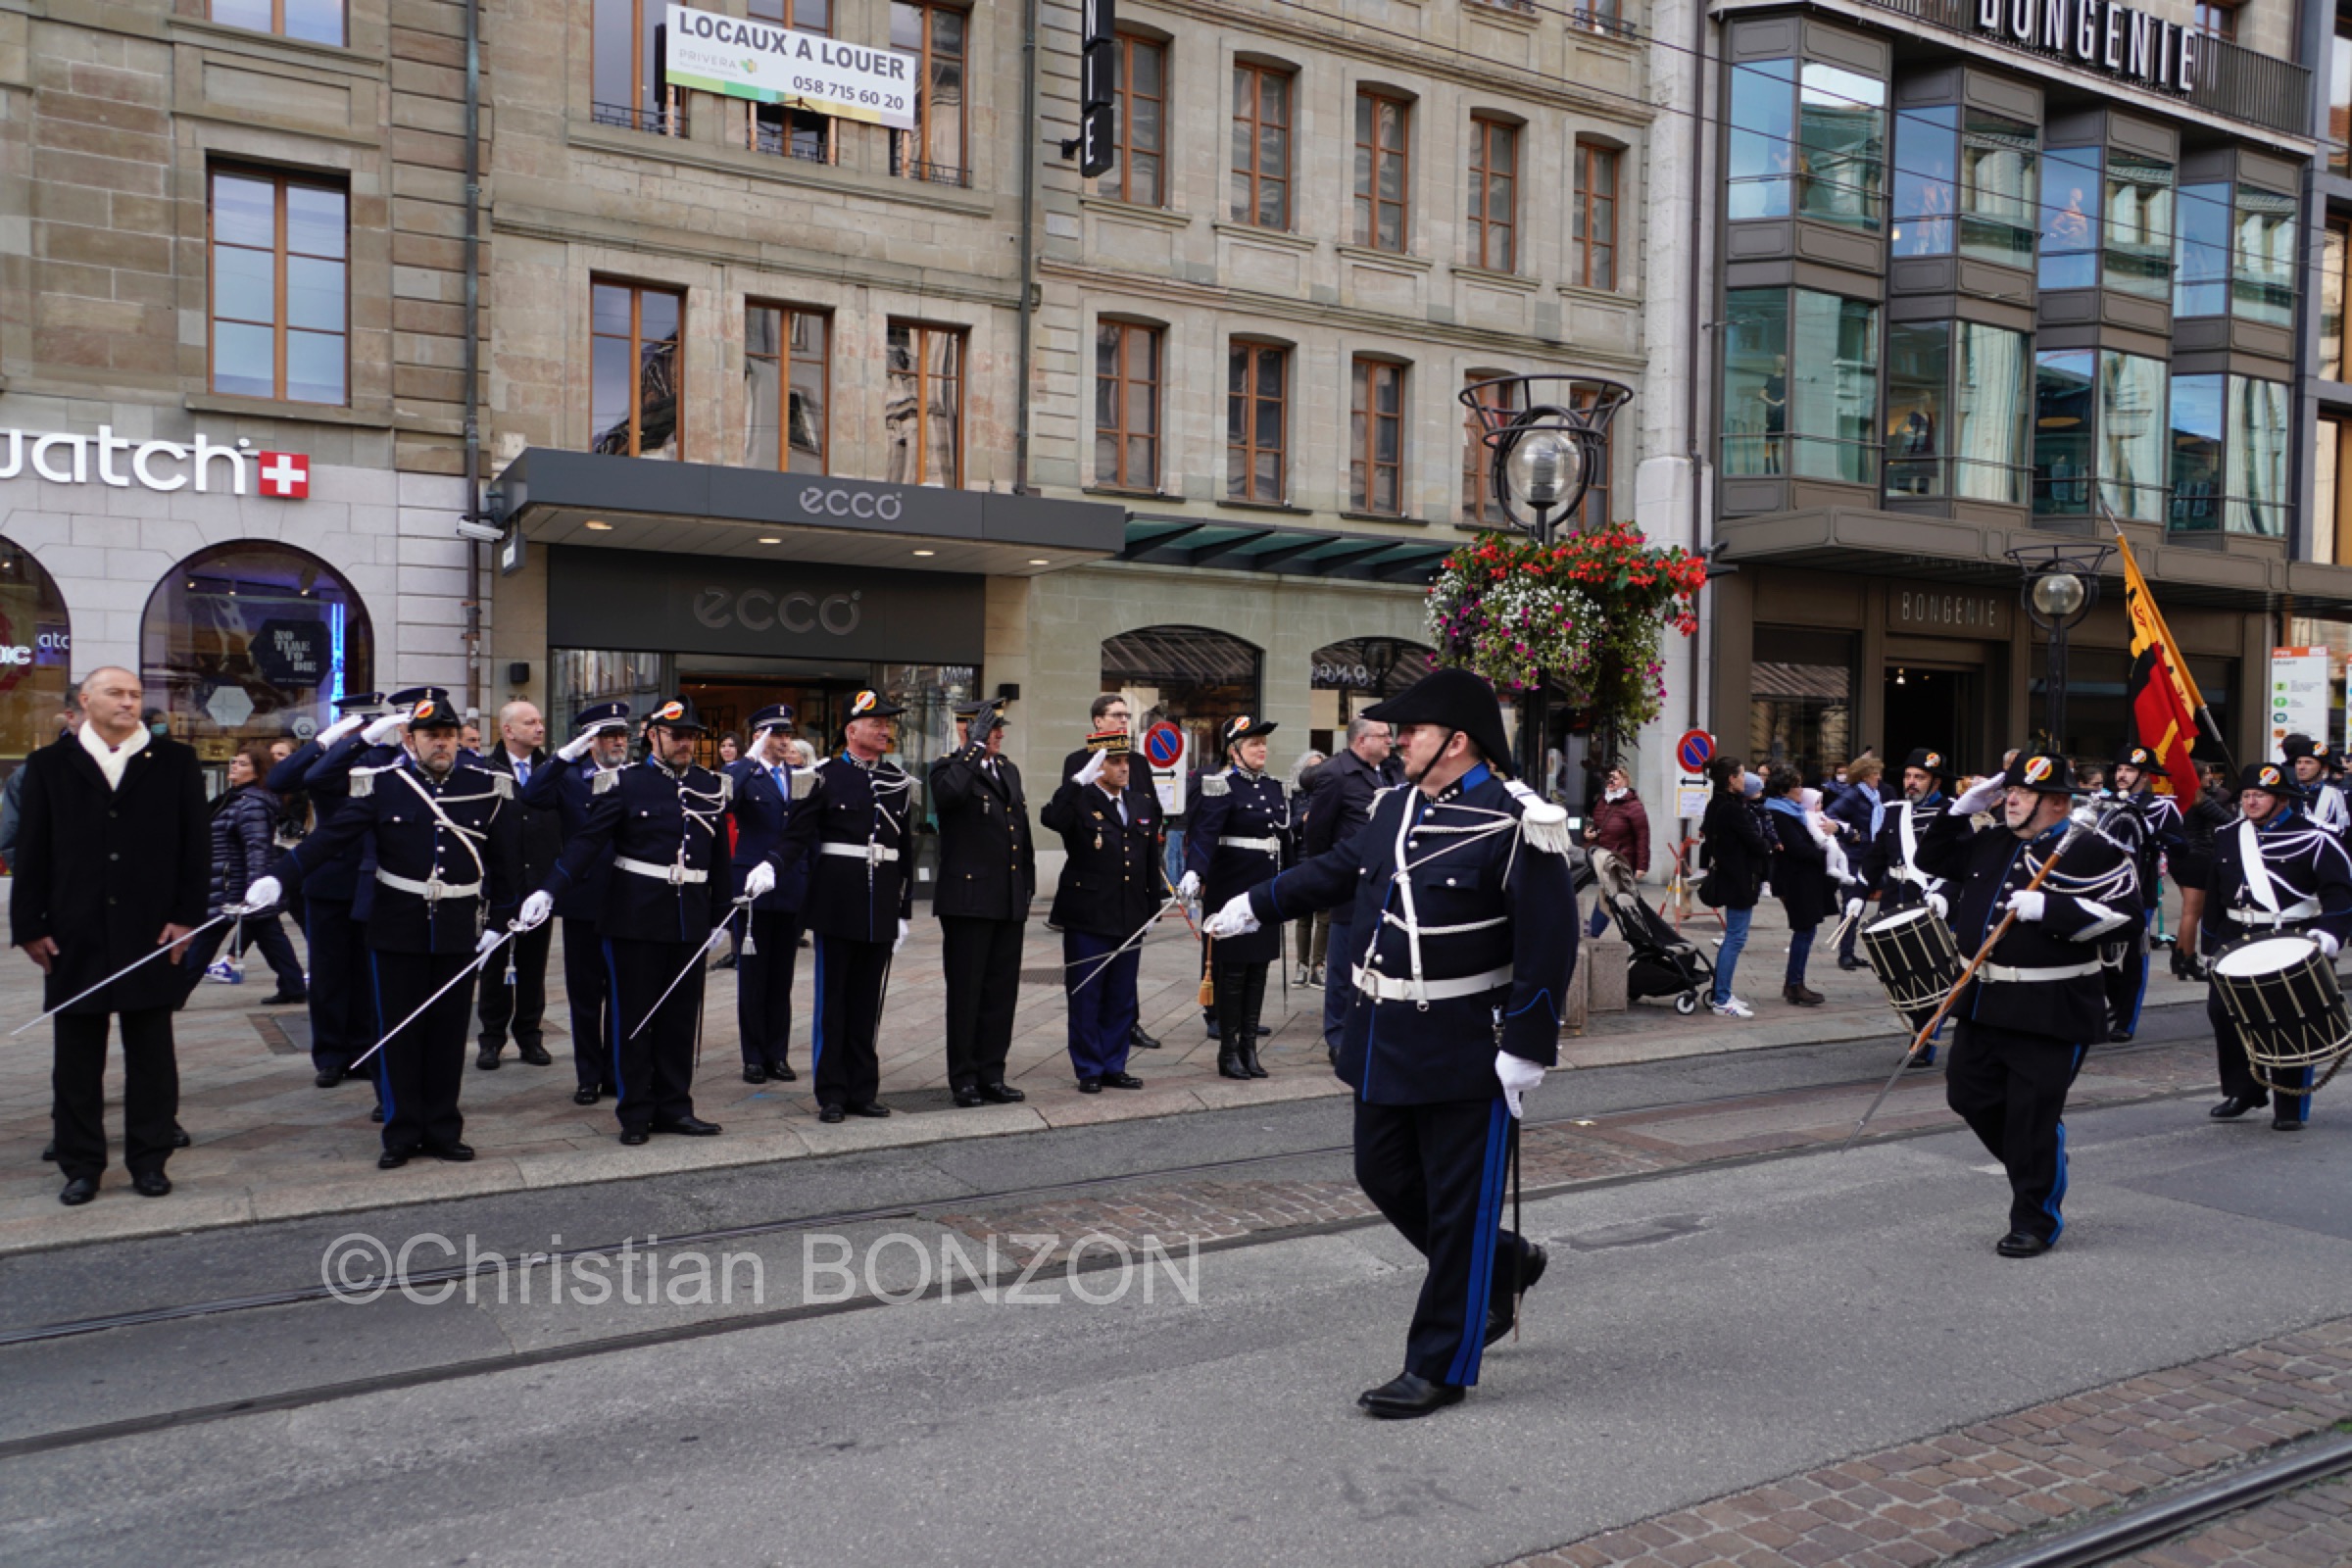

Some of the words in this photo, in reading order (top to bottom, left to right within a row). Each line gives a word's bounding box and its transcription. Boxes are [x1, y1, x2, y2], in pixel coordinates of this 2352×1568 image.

[679, 11, 788, 56] LOCAUX
[795, 37, 813, 62] A
[820, 42, 906, 80] LOUER
[679, 48, 738, 70] PRIVERA
[793, 75, 824, 94] 058
[828, 81, 856, 100] 715
[859, 89, 880, 105] 60
[883, 93, 905, 110] 20
[799, 486, 903, 520] ecco
[693, 585, 862, 636] ecco
[1902, 591, 1996, 627] BONGENIE
[35, 631, 70, 649] atc
